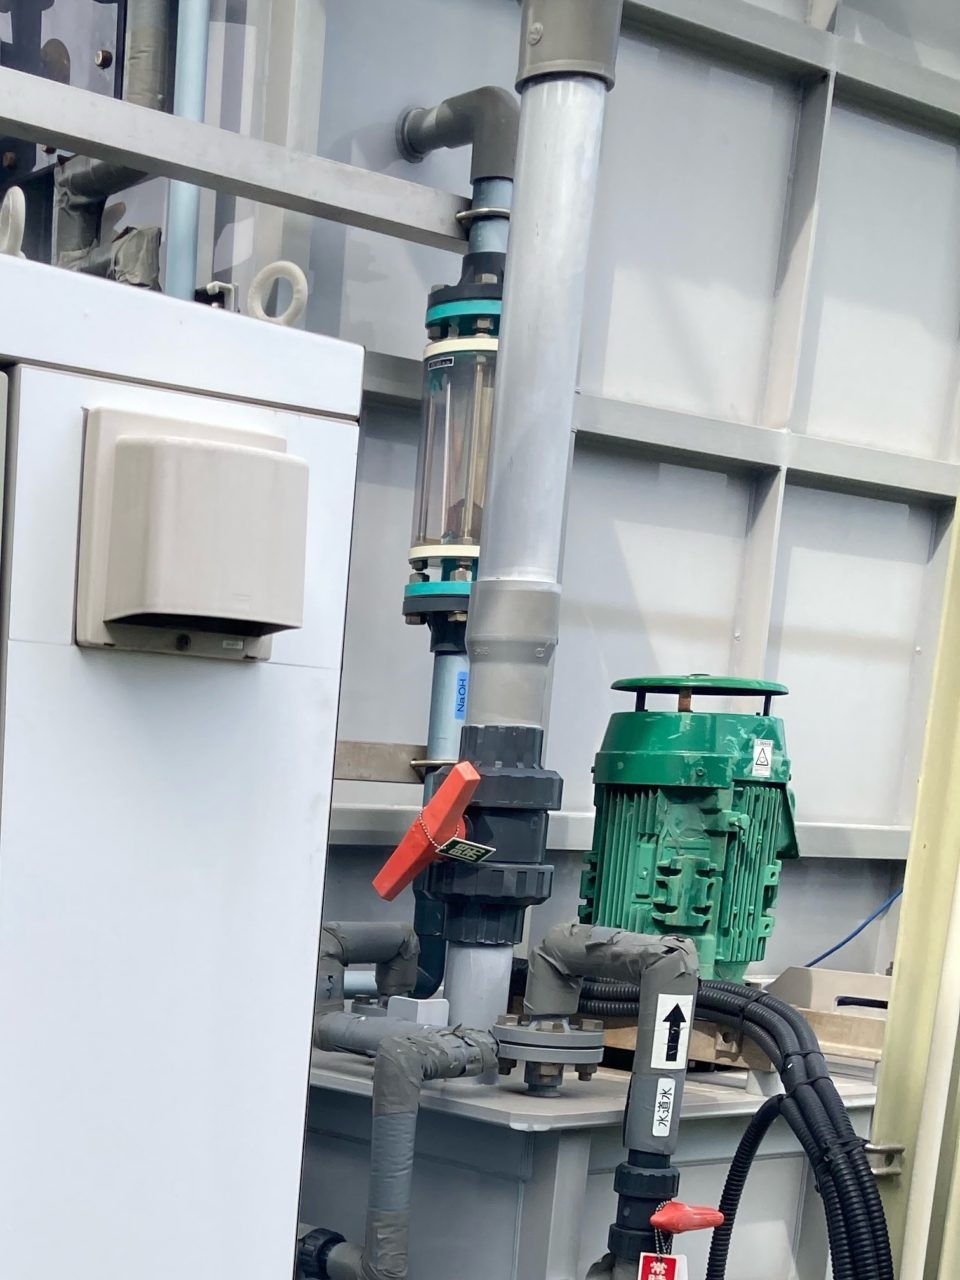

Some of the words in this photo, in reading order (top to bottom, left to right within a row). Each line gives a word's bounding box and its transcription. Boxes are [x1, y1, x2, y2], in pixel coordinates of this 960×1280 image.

[456, 678, 467, 713] NaOH
[656, 1087, 673, 1127] 水道水
